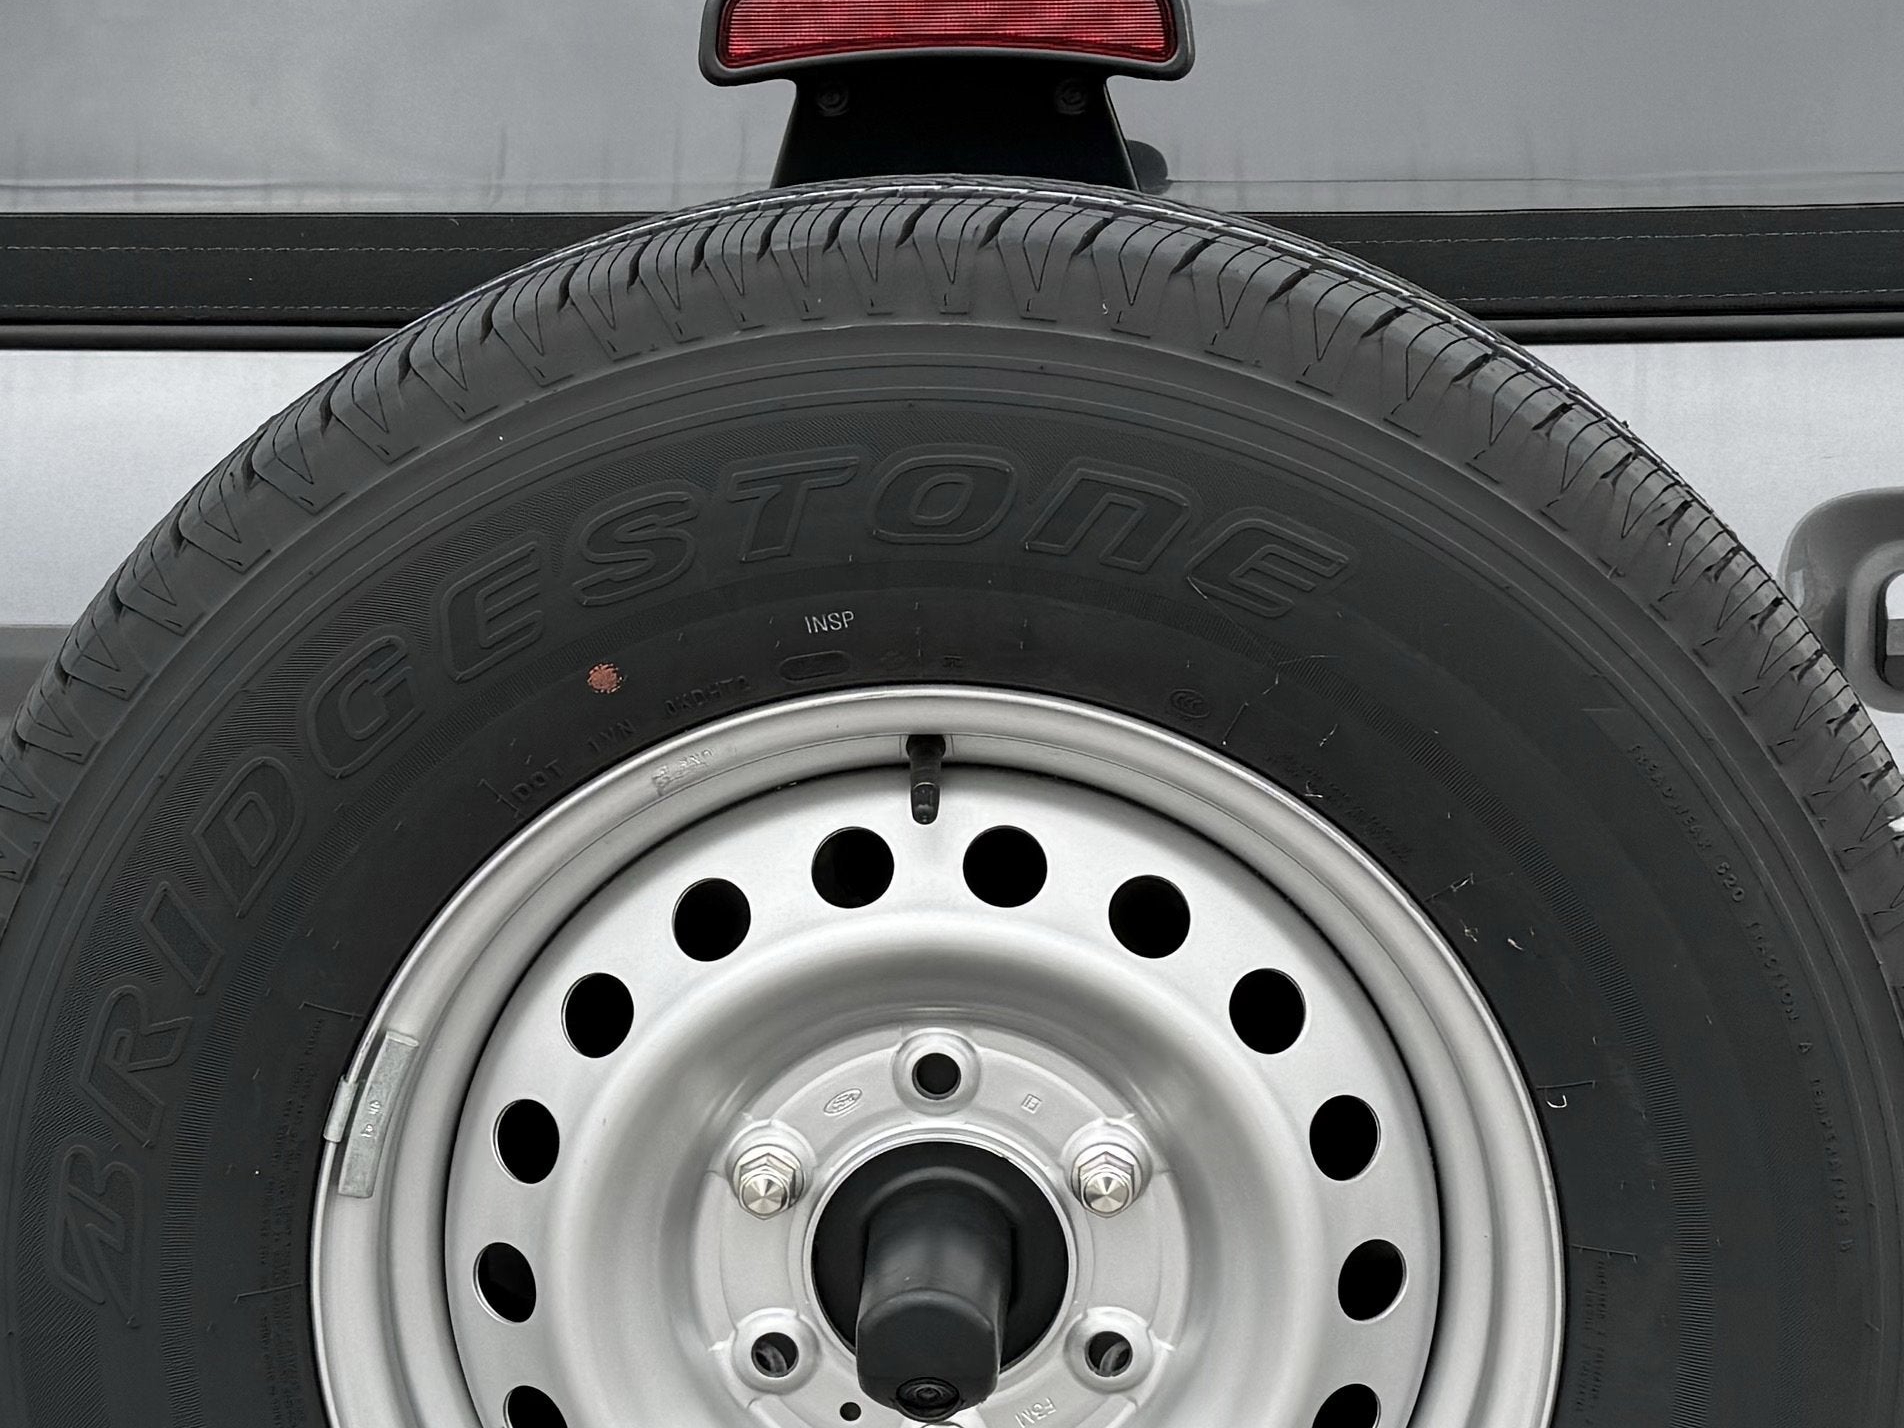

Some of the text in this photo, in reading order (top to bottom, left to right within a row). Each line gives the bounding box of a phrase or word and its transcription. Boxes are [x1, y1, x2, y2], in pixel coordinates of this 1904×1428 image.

[804, 610, 856, 635] INSP
[512, 759, 560, 802] DOT
[43, 444, 1358, 1309] BRIDGESTONE
[1714, 860, 1746, 902] 520
